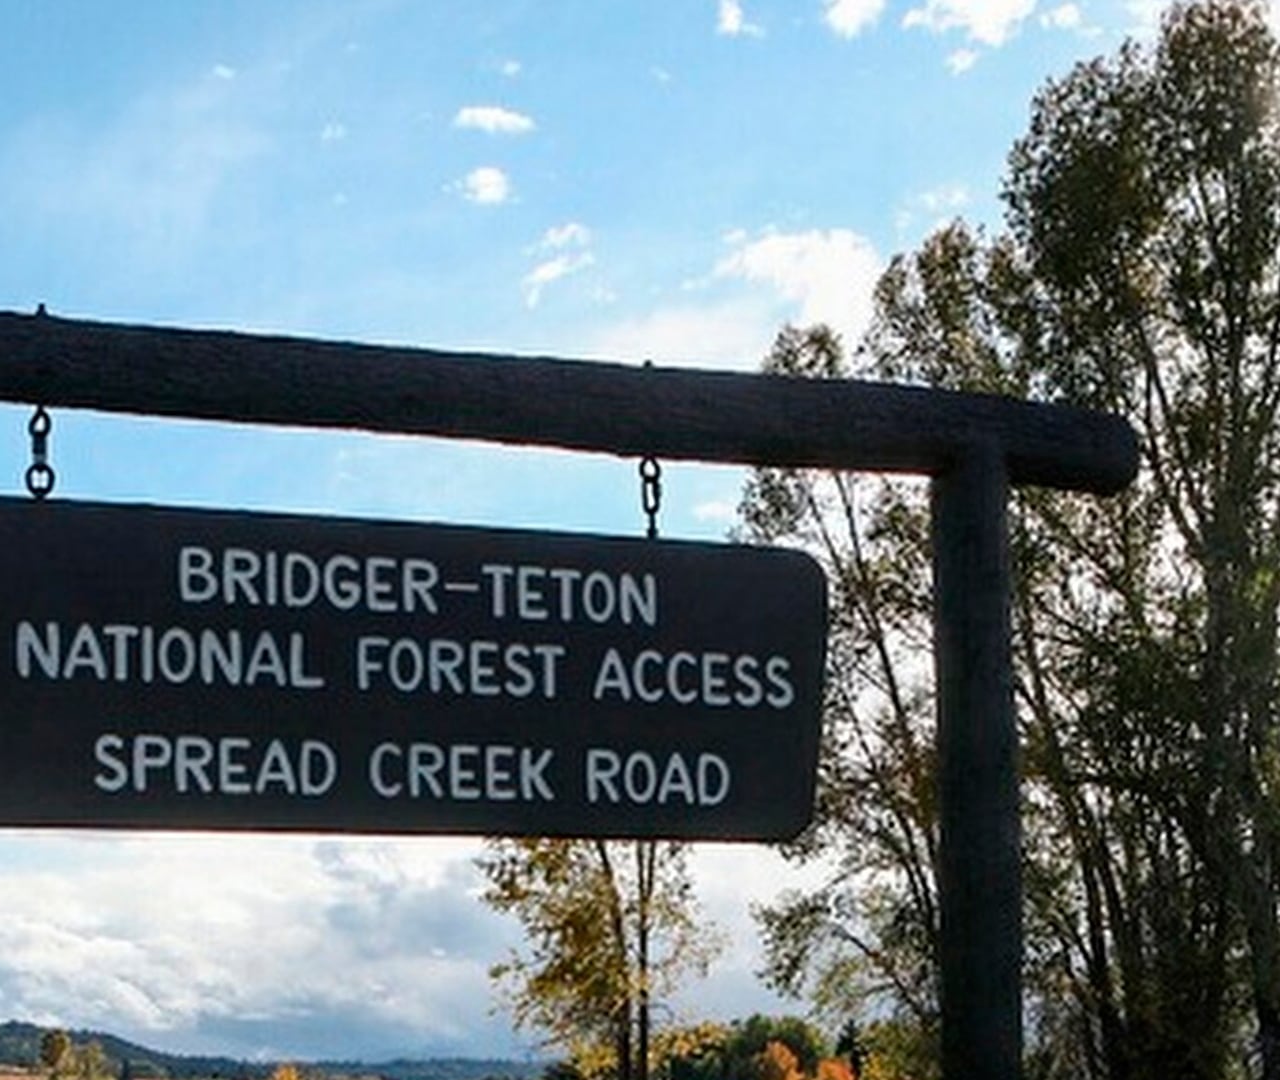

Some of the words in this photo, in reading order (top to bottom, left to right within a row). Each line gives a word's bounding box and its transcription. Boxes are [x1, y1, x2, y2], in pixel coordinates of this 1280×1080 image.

[179, 546, 657, 625] BRIDGER-TETON
[17, 621, 324, 689] NATIONAL
[357, 636, 564, 699] FOREST
[593, 649, 794, 709] ACCESS
[93, 733, 336, 796] SPREAD
[370, 743, 555, 801] CREEK
[587, 749, 730, 806] ROAD
